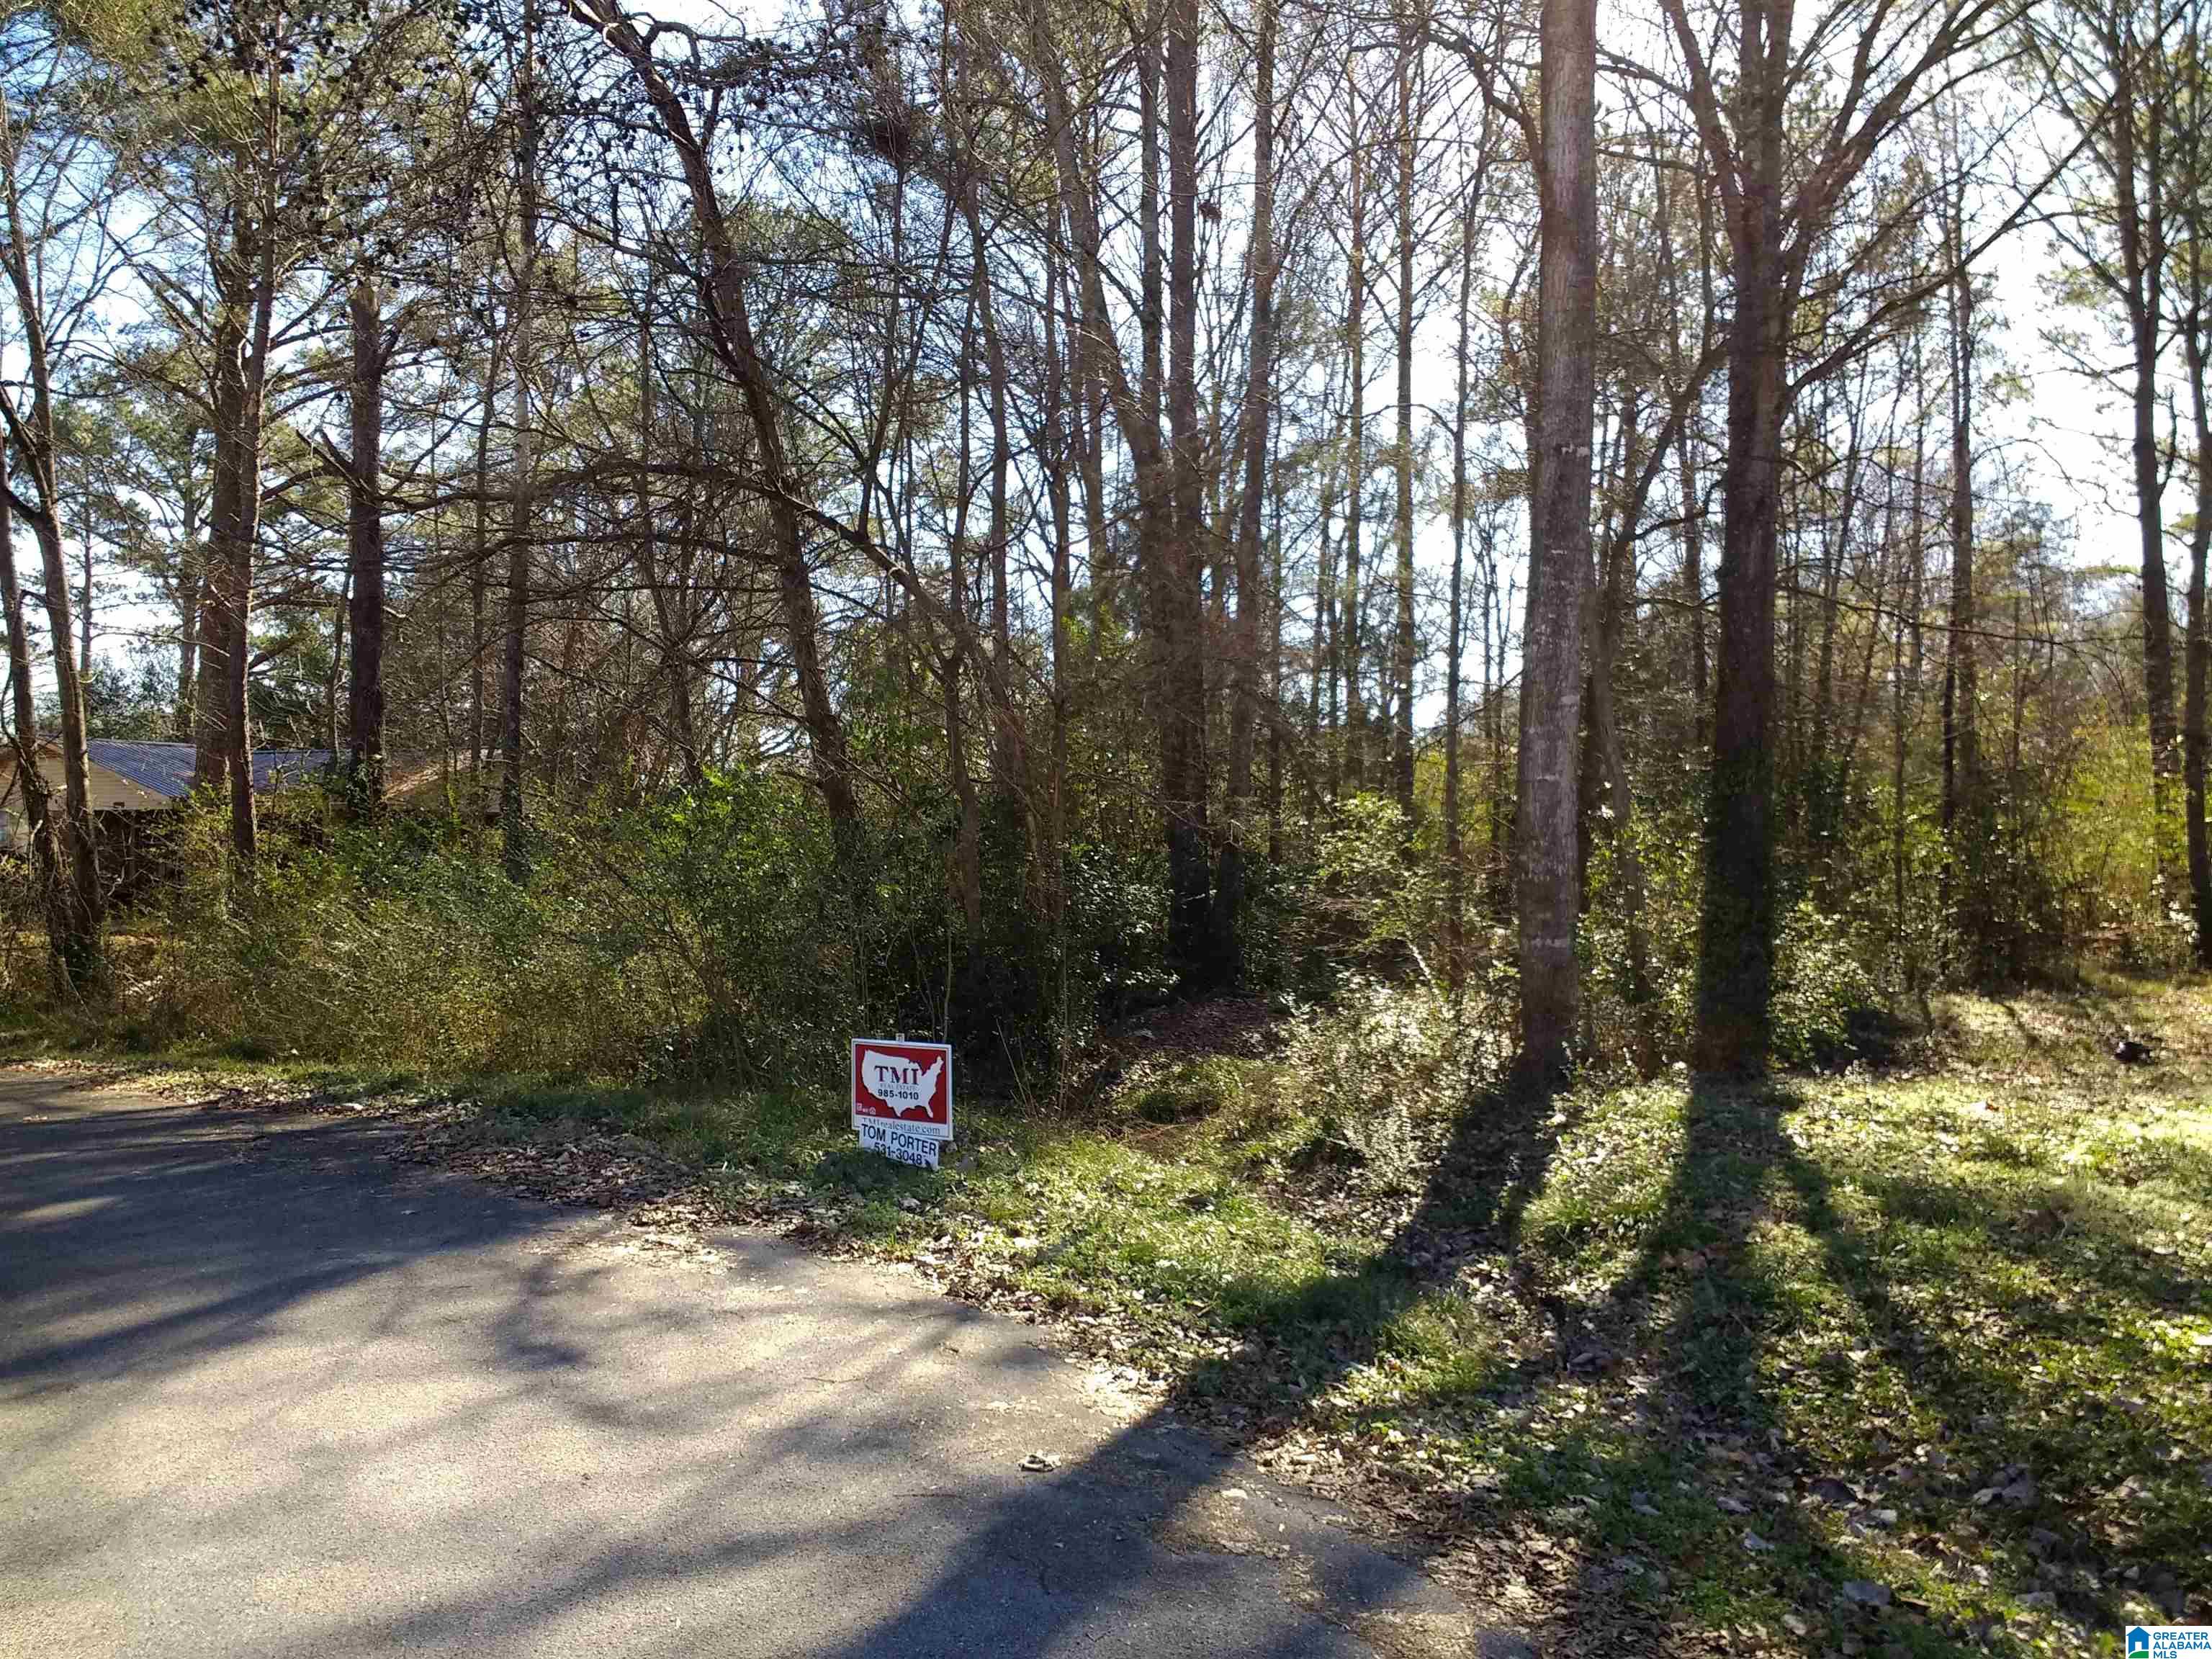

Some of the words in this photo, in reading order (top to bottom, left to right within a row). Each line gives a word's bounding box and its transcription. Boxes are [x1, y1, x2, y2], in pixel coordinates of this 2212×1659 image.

[874, 1066, 920, 1085] TMI
[878, 1089, 919, 1100] 985-1010
[861, 1123, 886, 1142] TOM
[891, 1131, 937, 1156] PORTER
[874, 1142, 922, 1165] 531-3048
